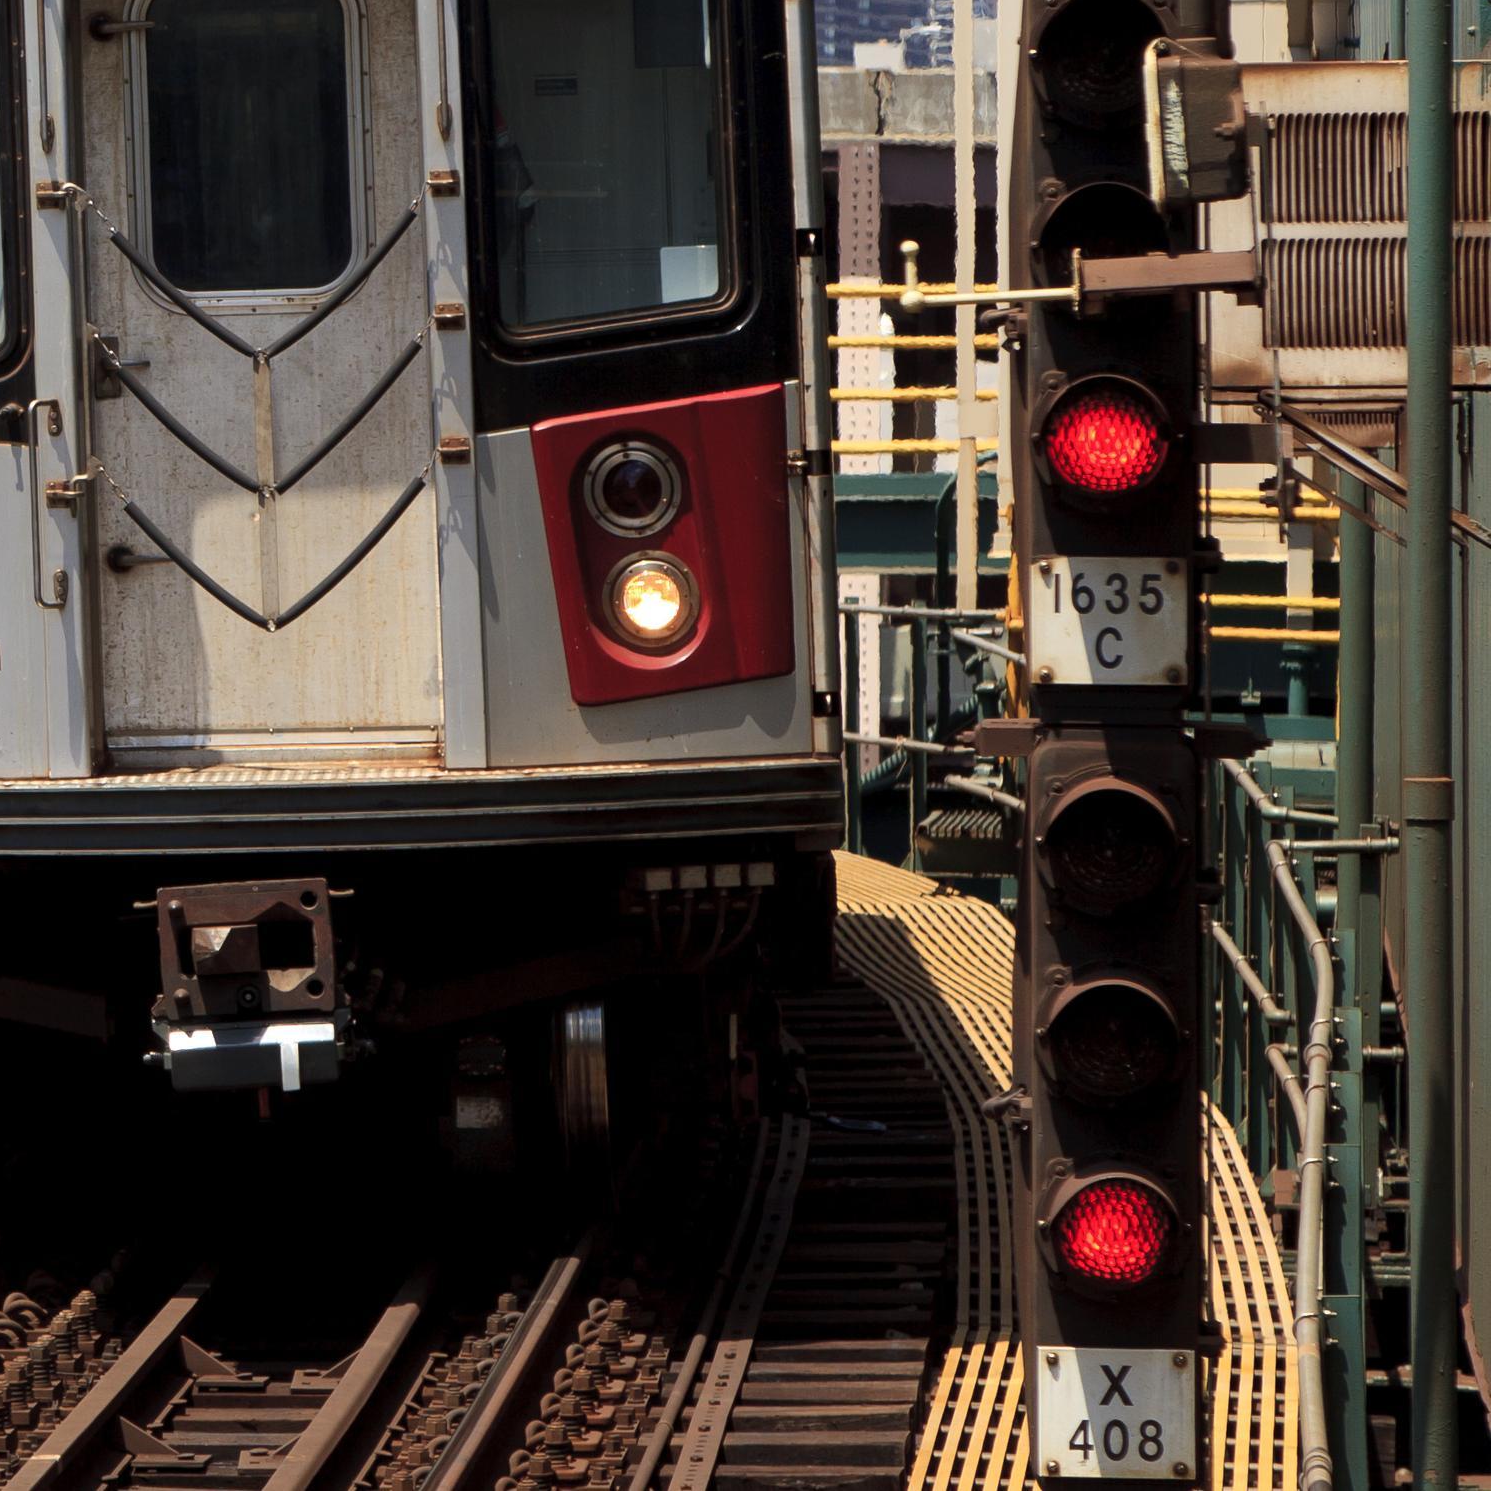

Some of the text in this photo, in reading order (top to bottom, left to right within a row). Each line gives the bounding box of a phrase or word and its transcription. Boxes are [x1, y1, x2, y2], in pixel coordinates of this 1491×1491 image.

[1053, 572, 1164, 616] 1635
[1095, 626, 1124, 669] C
[1099, 1364, 1134, 1407] X
[1068, 1418, 1165, 1462] 408
